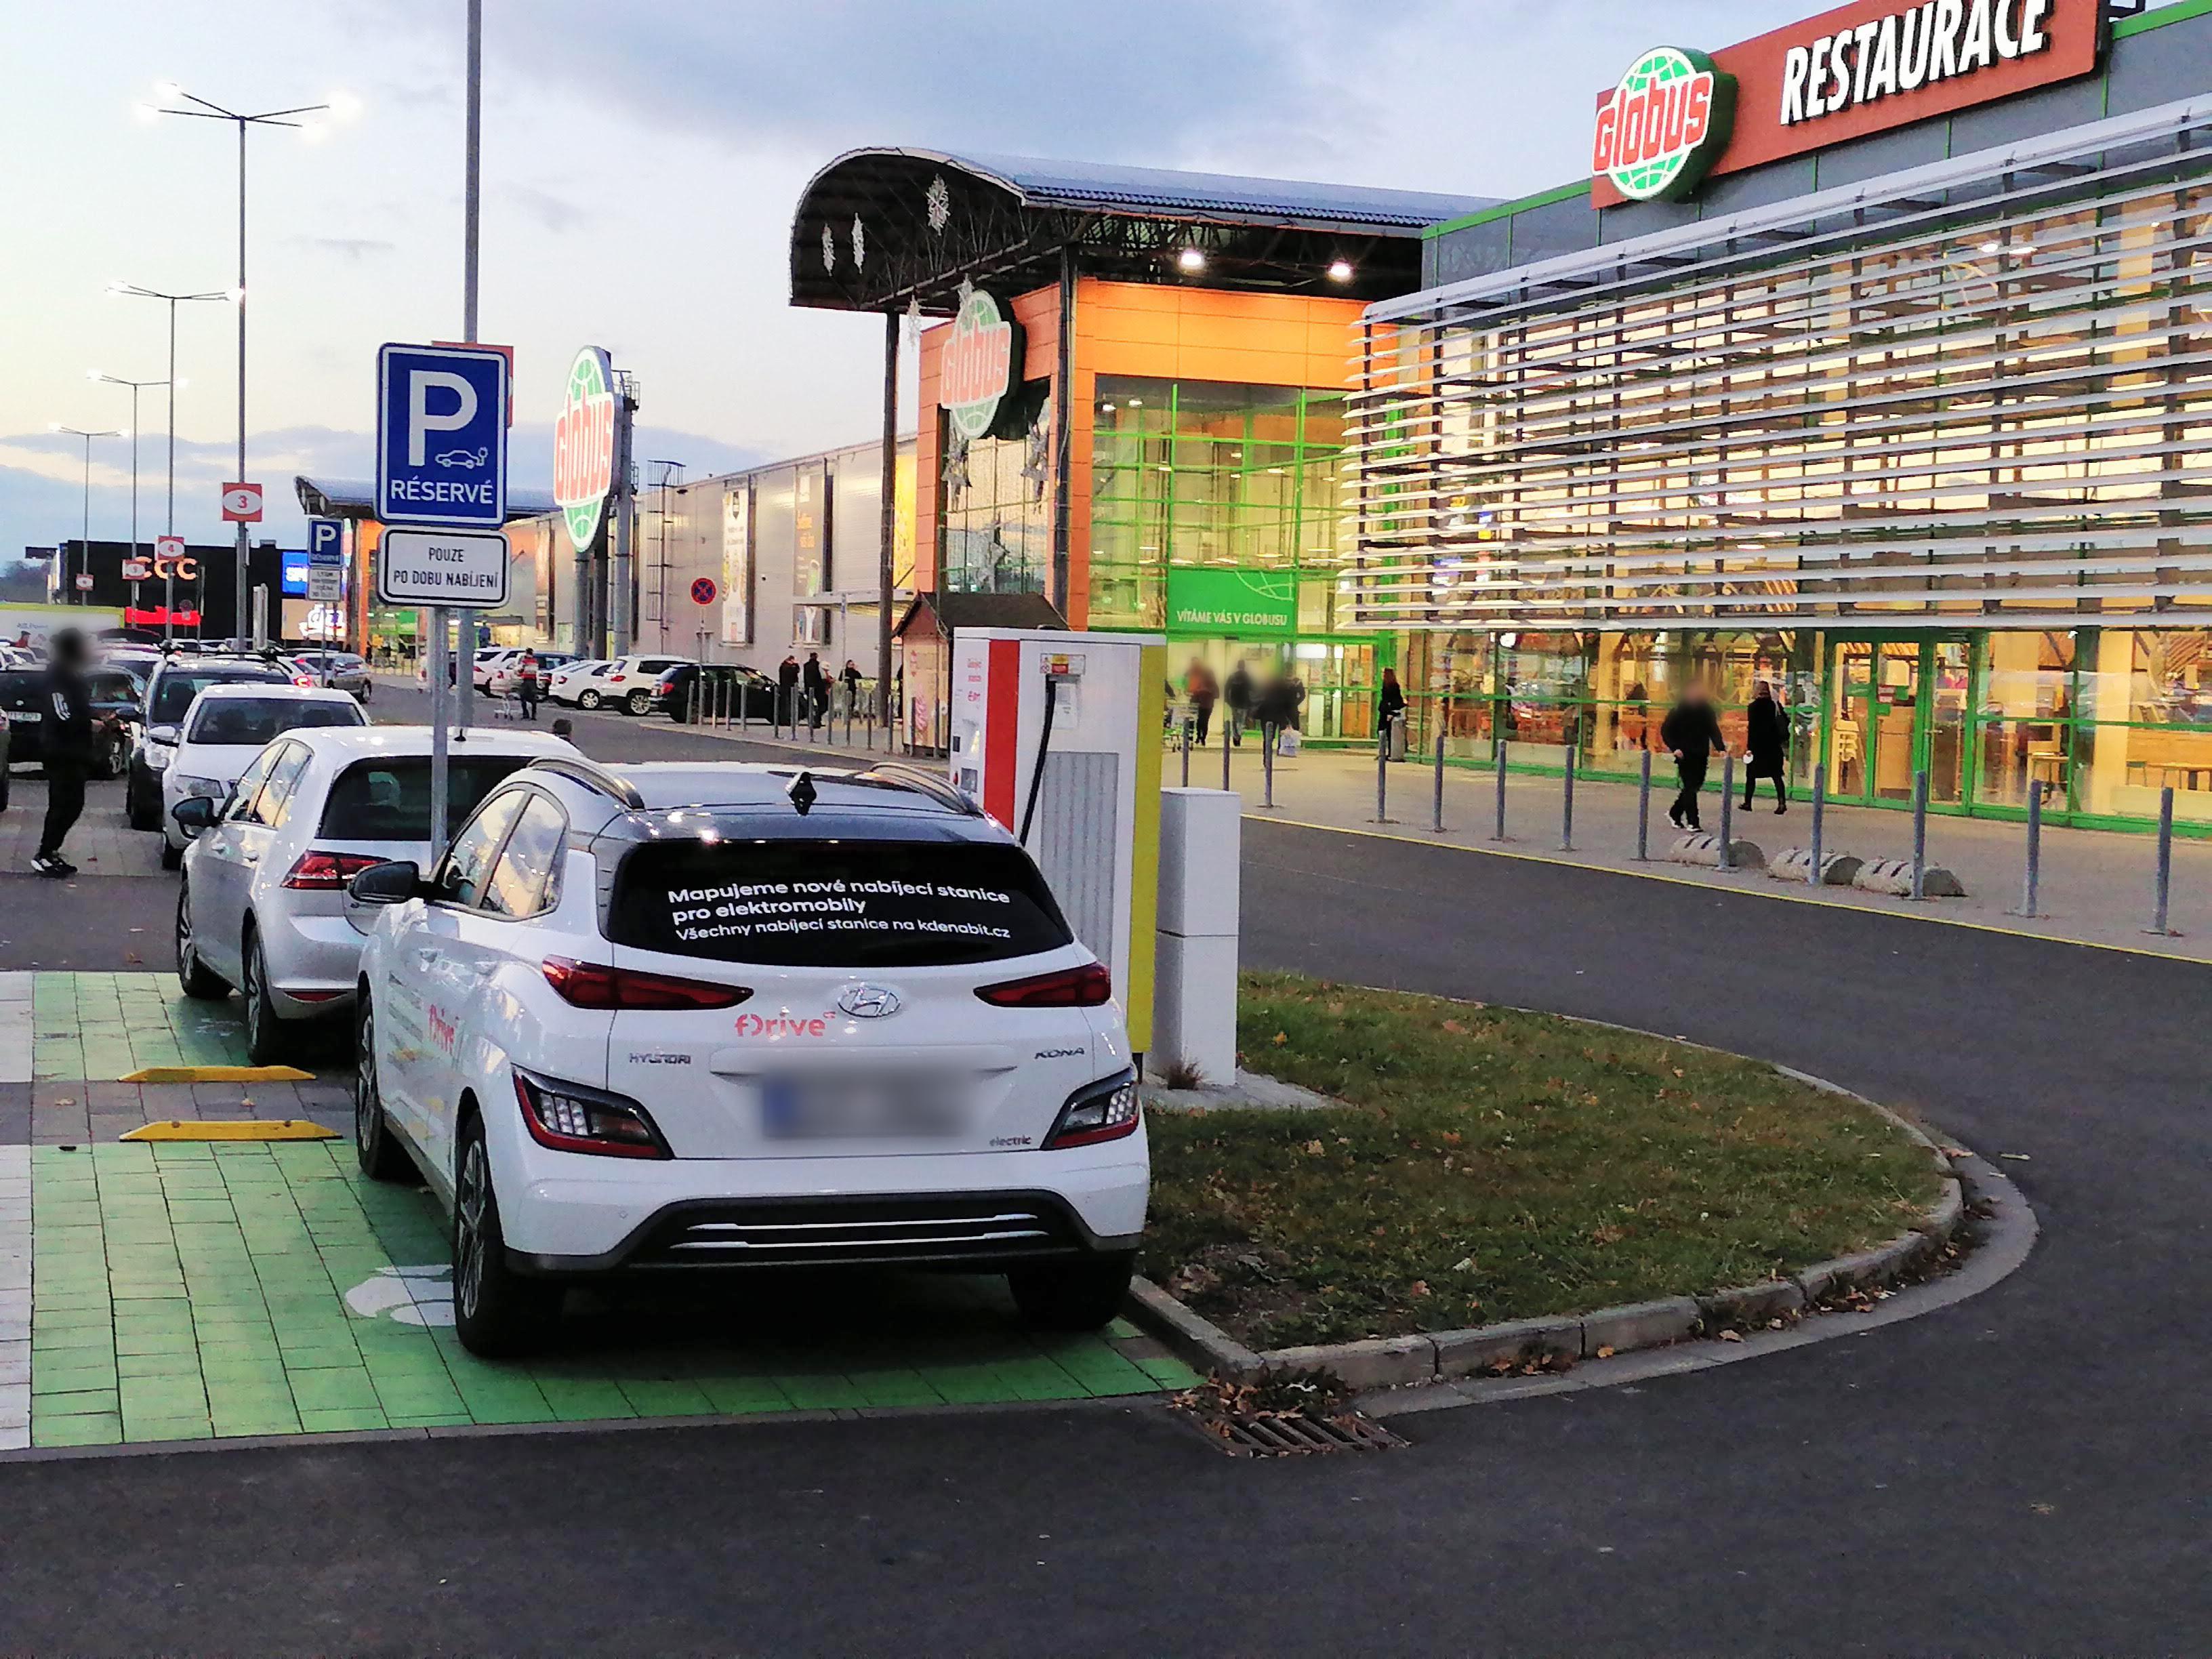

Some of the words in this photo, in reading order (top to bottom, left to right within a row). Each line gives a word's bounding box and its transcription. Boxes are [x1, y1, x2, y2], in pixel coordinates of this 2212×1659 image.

[1780, 0, 2045, 125] RESTAURACE
[408, 369, 478, 466] P
[390, 475, 493, 505] RÉSERVÉ
[237, 495, 247, 509] 3
[316, 525, 336, 552] P
[428, 547, 464, 562] POUZE
[394, 570, 408, 583] PO
[412, 570, 442, 586] DOBU
[446, 571, 499, 588] NABÍJENÍ
[1213, 609, 1232, 624] VÁS
[1233, 613, 1242, 624] V
[1243, 613, 1288, 626] GLOBUSU
[668, 883, 789, 903] Mapujeme
[792, 880, 846, 893] nové
[850, 880, 934, 896] nabíjecí
[937, 886, 1010, 903] stanice
[672, 908, 712, 926] pro
[715, 898, 866, 918] elektromobily
[675, 924, 752, 941] Všechny
[755, 918, 823, 934] nabíjecí
[827, 918, 889, 930] stanice
[892, 920, 916, 930] na
[917, 919, 1011, 939] kdenabit.cz
